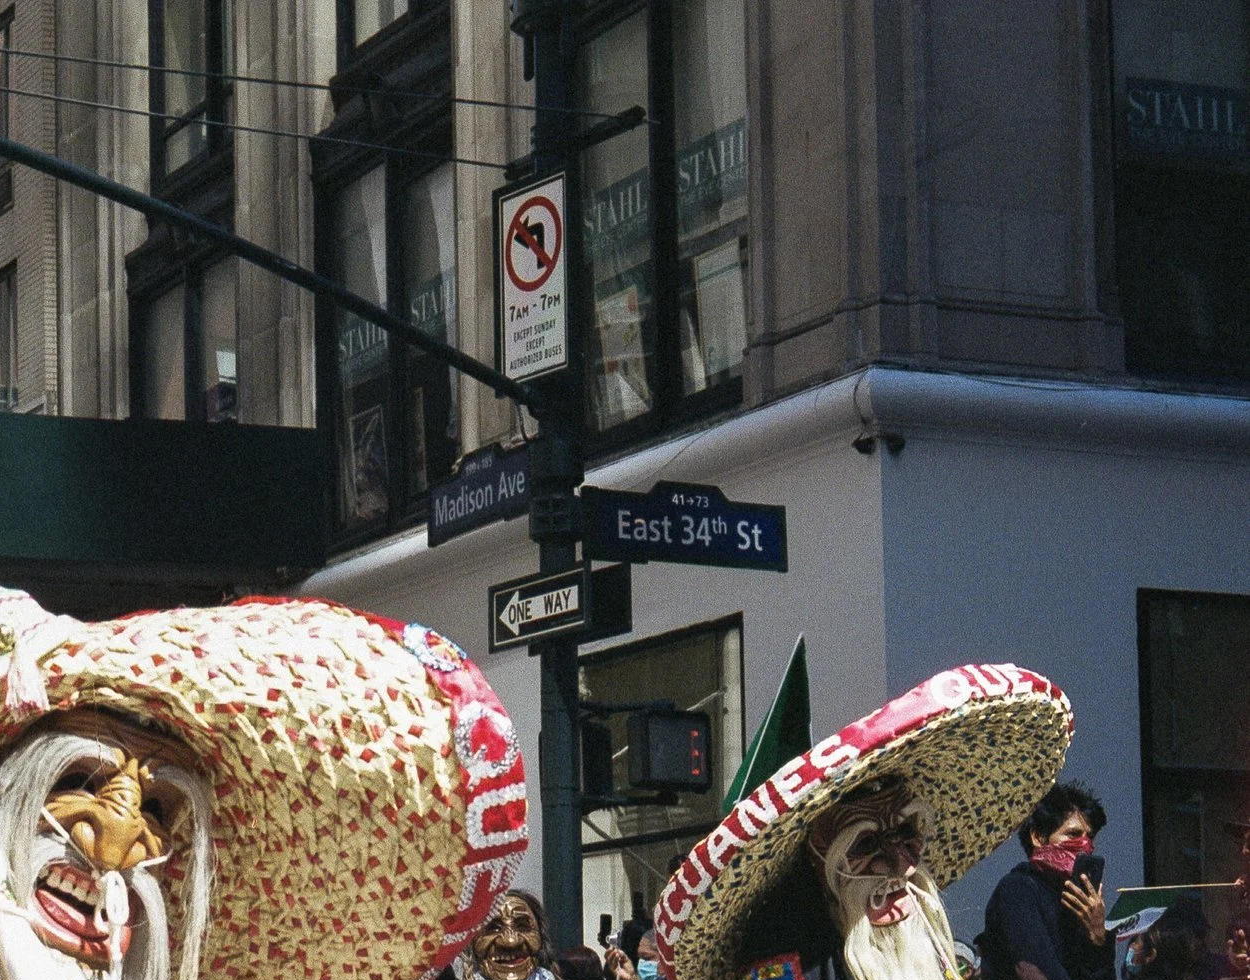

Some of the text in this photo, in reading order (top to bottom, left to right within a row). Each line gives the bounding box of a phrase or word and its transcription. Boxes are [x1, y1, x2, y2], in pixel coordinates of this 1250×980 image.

[509, 305, 529, 323] 7AM
[540, 293, 561, 312] 7PM
[513, 318, 556, 343] EXCEPT SUNDAY
[525, 335, 545, 352] EXCEPT
[509, 344, 562, 371] AUTHORIZED BUSES
[434, 471, 525, 526] Madison Ave
[617, 509, 764, 552] East 34th St
[508, 589, 572, 625] ONE WAY
